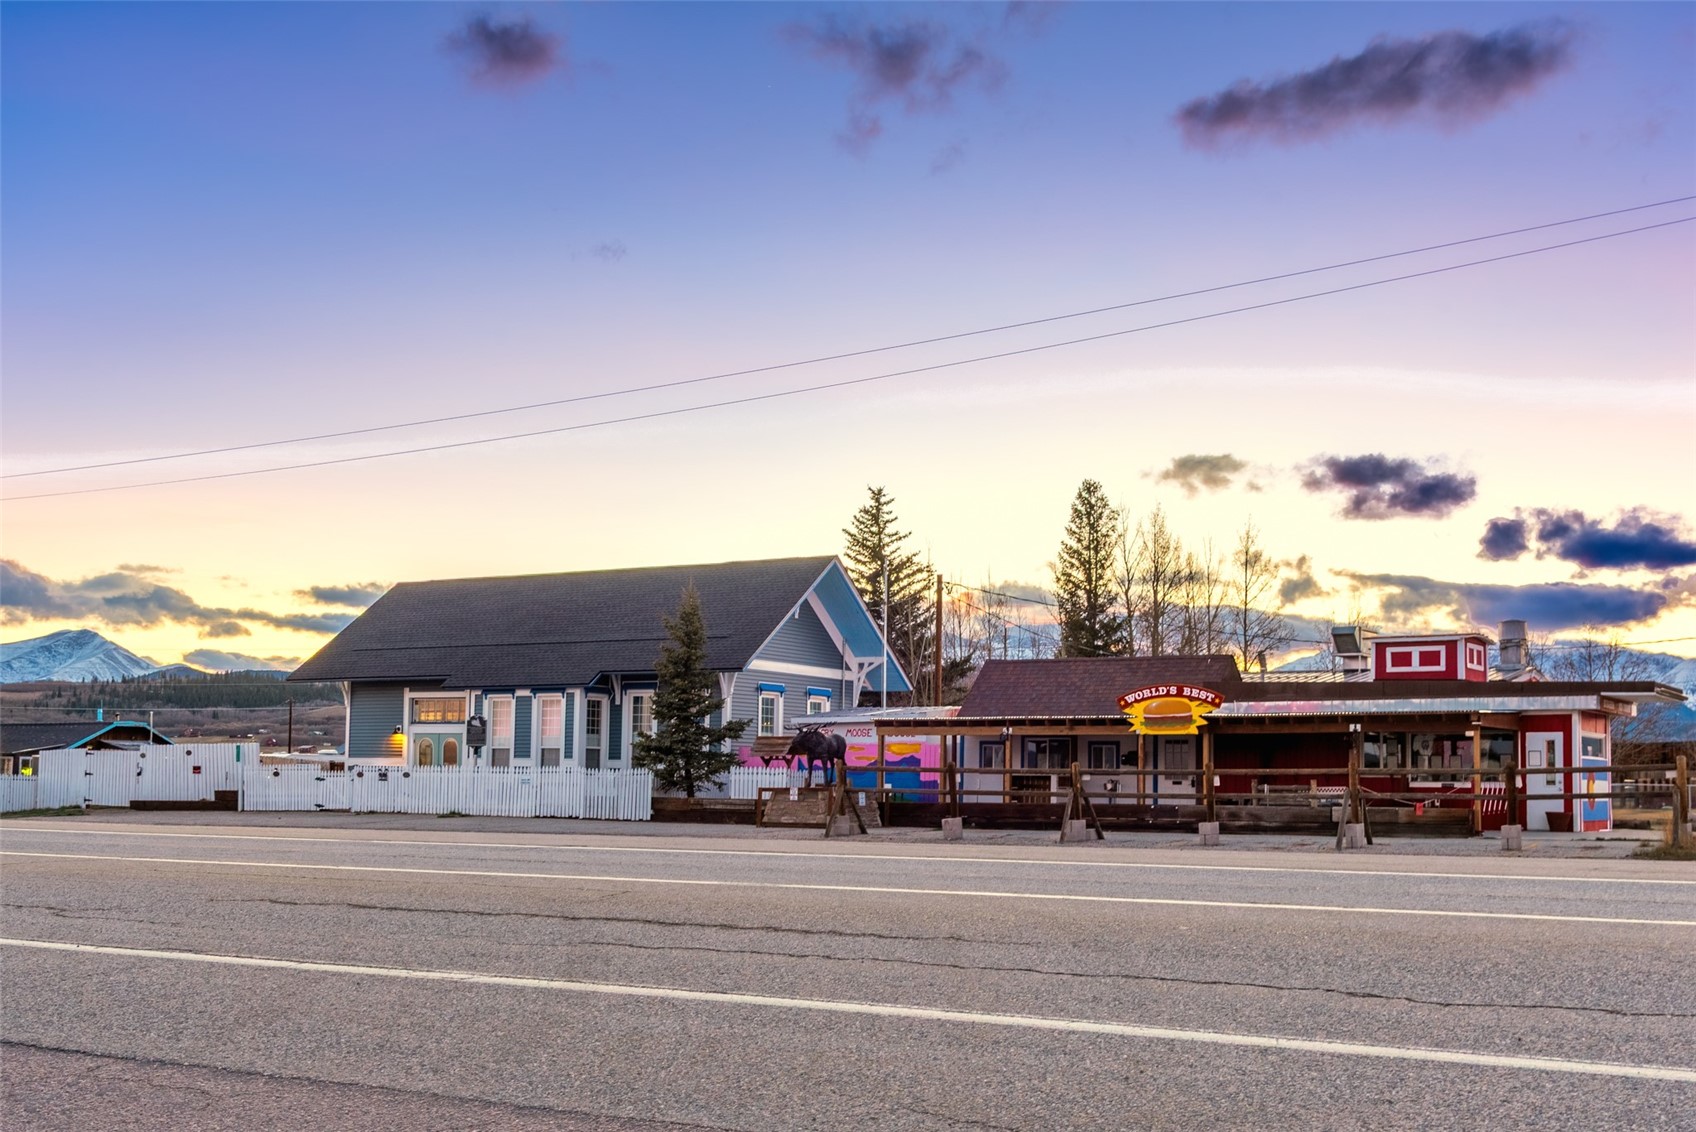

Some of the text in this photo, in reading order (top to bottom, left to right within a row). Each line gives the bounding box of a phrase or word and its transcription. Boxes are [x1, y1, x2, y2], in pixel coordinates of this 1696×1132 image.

[1124, 686, 1215, 704] WORLD'S BEST
[845, 728, 873, 738] MOOSE
